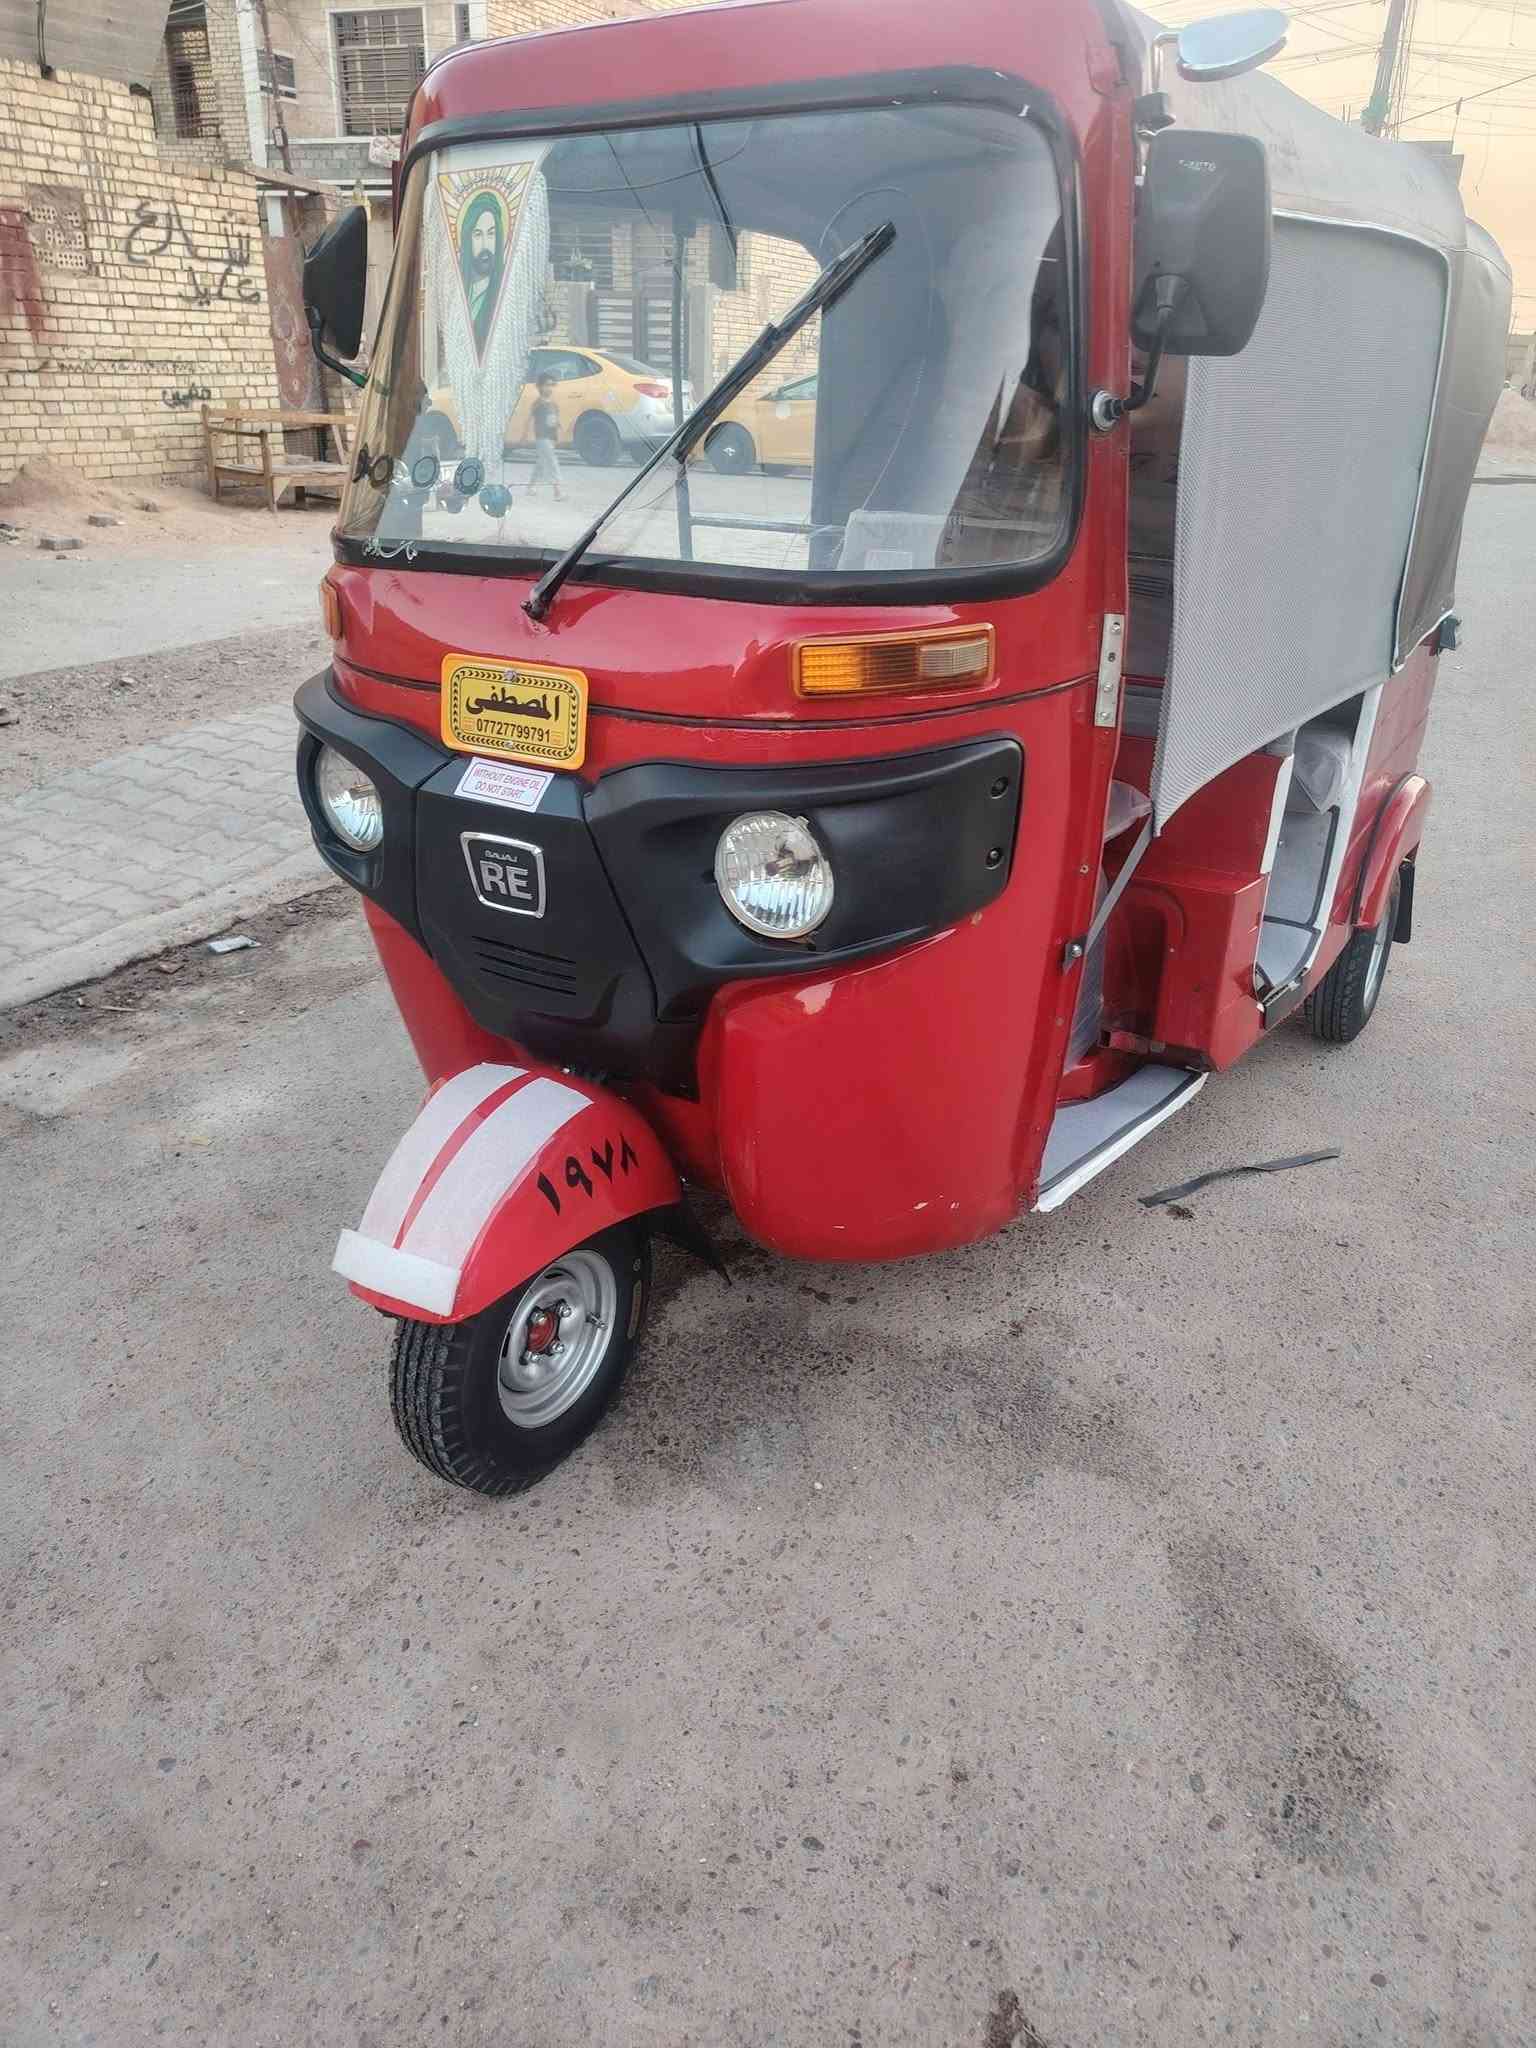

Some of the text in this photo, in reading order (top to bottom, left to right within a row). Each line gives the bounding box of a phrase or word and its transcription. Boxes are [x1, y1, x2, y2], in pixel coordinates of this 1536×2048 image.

[465, 686, 560, 721] المصطفى
[476, 718, 551, 743] 07727799791
[473, 767, 505, 782] WITHOUT
[475, 781, 526, 799] DO NOT START
[484, 850, 518, 863] BAJAJ
[479, 859, 534, 900] RE
[537, 1129, 640, 1217] ١٩٧٨
